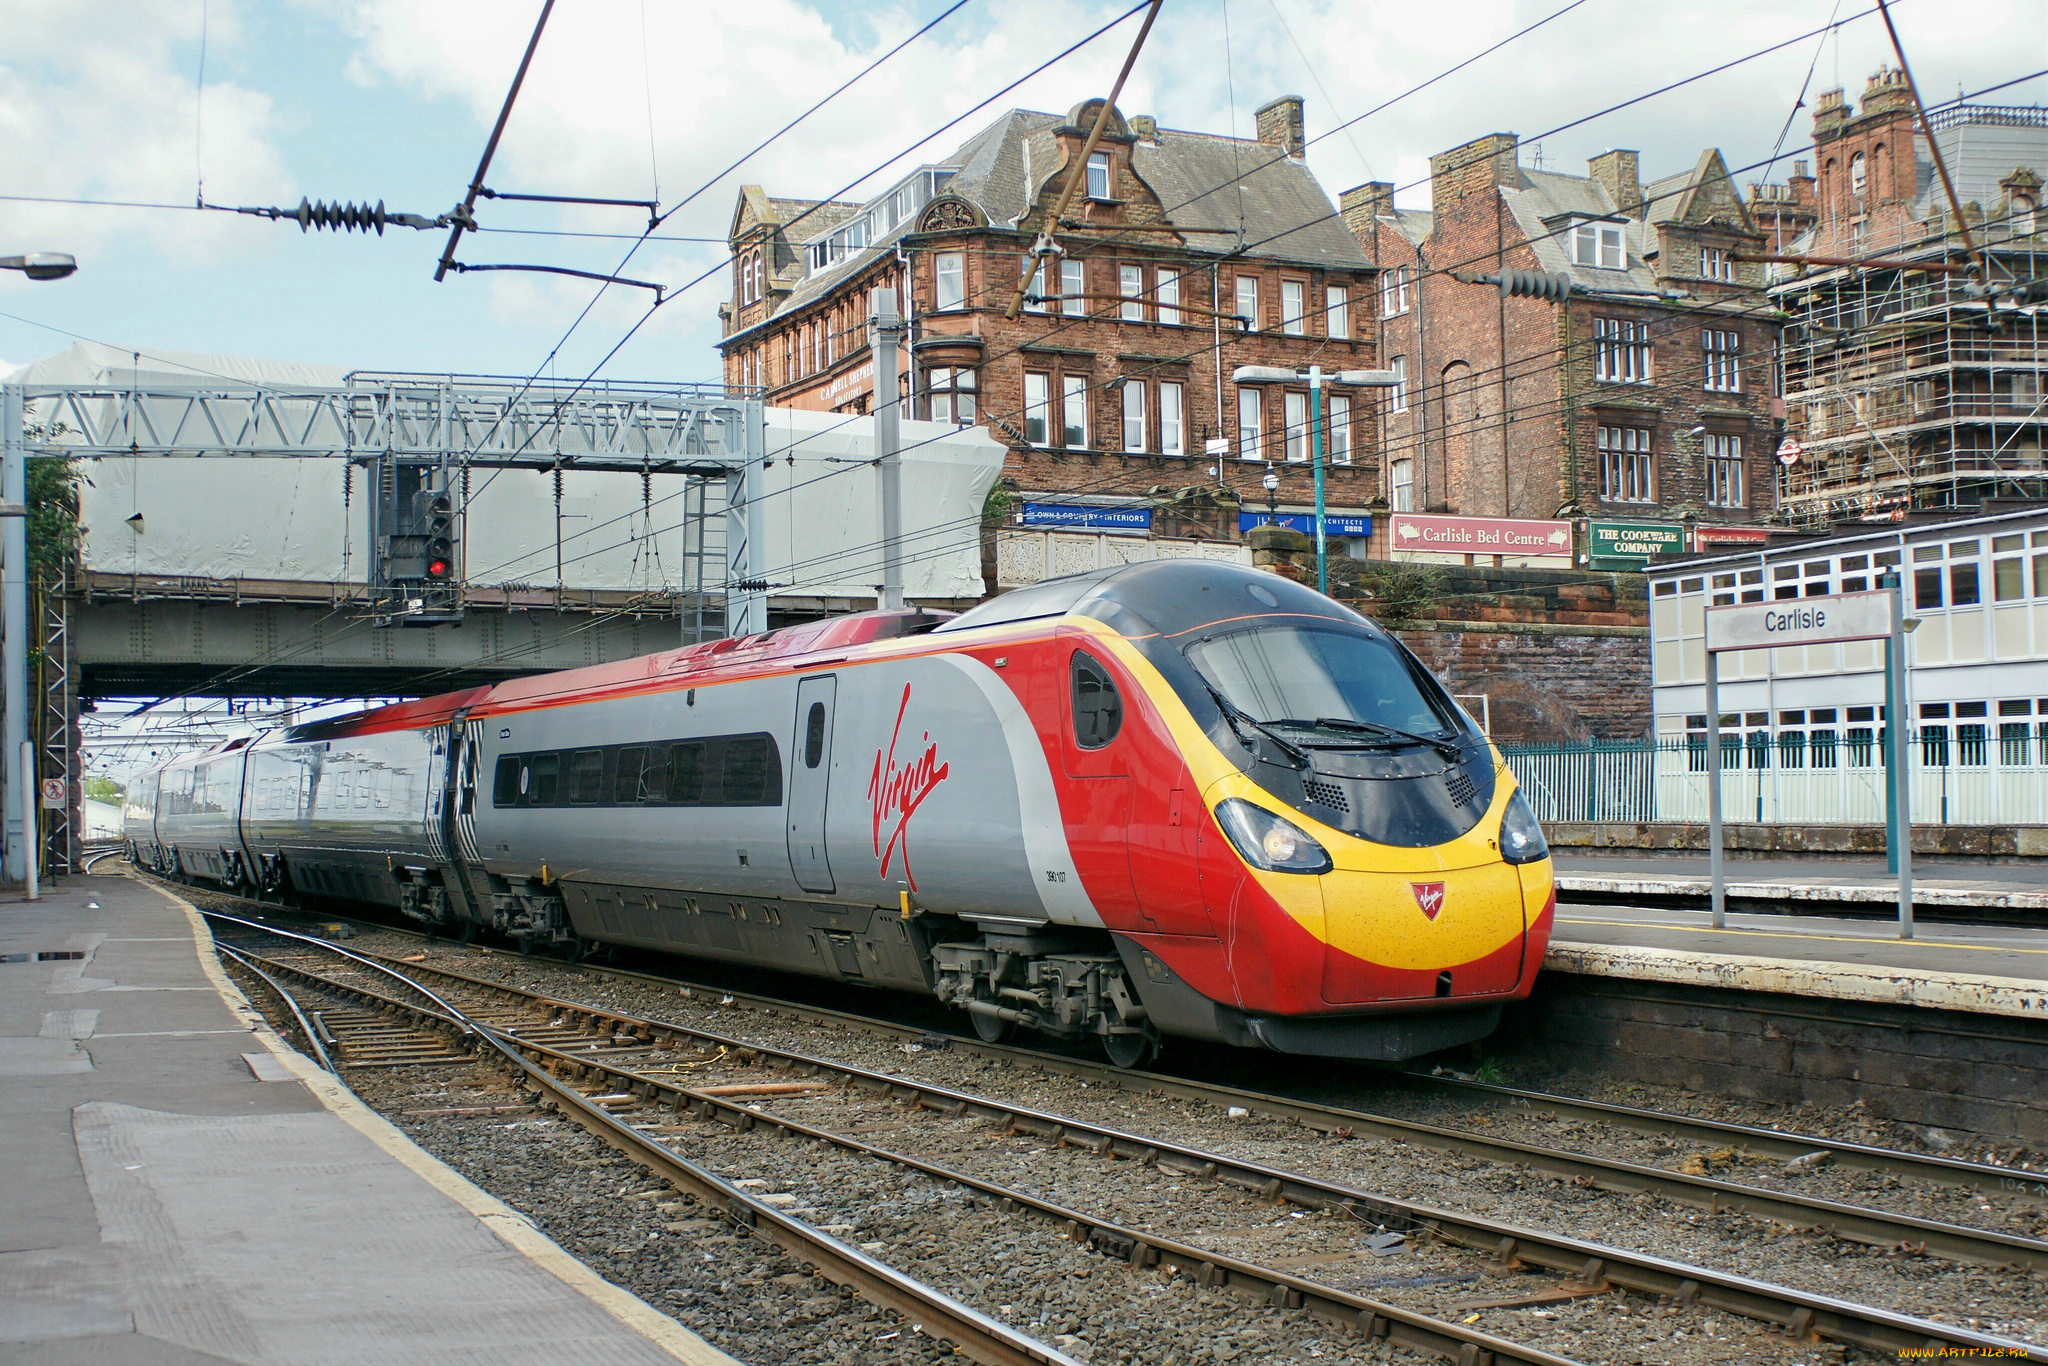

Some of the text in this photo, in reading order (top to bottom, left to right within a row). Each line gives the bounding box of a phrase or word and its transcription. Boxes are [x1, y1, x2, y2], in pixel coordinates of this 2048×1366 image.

[1104, 513, 1145, 523] INTERIORS
[1323, 518, 1363, 526] RCHITECTS
[1423, 527, 1545, 546] Carlisle Bed Centre
[1598, 529, 1678, 542] THE COOKWARE
[1614, 542, 1663, 553] COMPANY
[1765, 606, 1826, 632] Carlisle
[866, 680, 949, 894] Virgin
